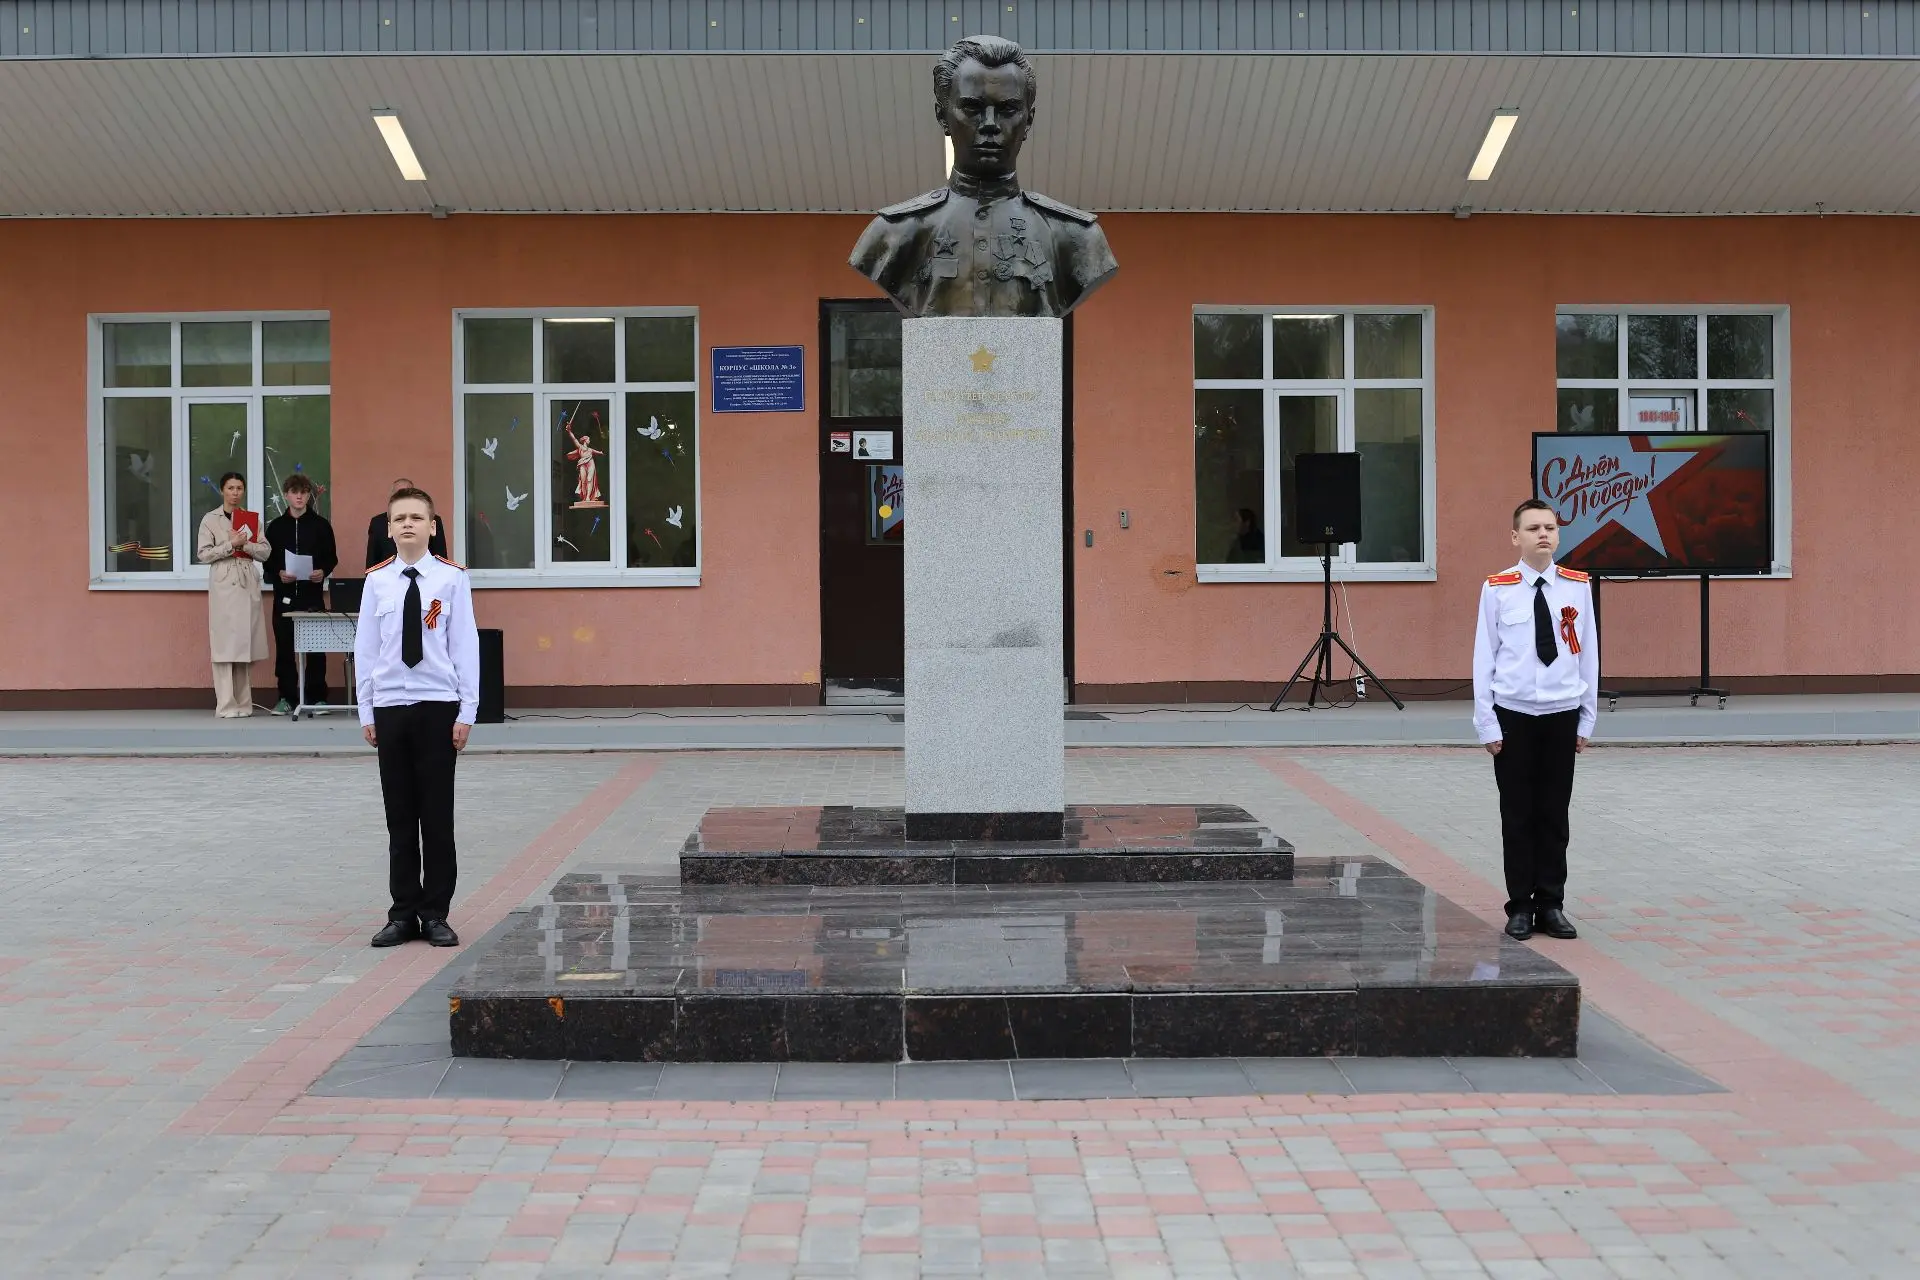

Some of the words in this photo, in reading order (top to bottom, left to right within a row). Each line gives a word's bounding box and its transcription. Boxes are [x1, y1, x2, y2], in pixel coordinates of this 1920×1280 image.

[1541, 456, 1567, 499] С
[1565, 454, 1620, 490] Днём
[1556, 454, 1656, 527] Победы!
